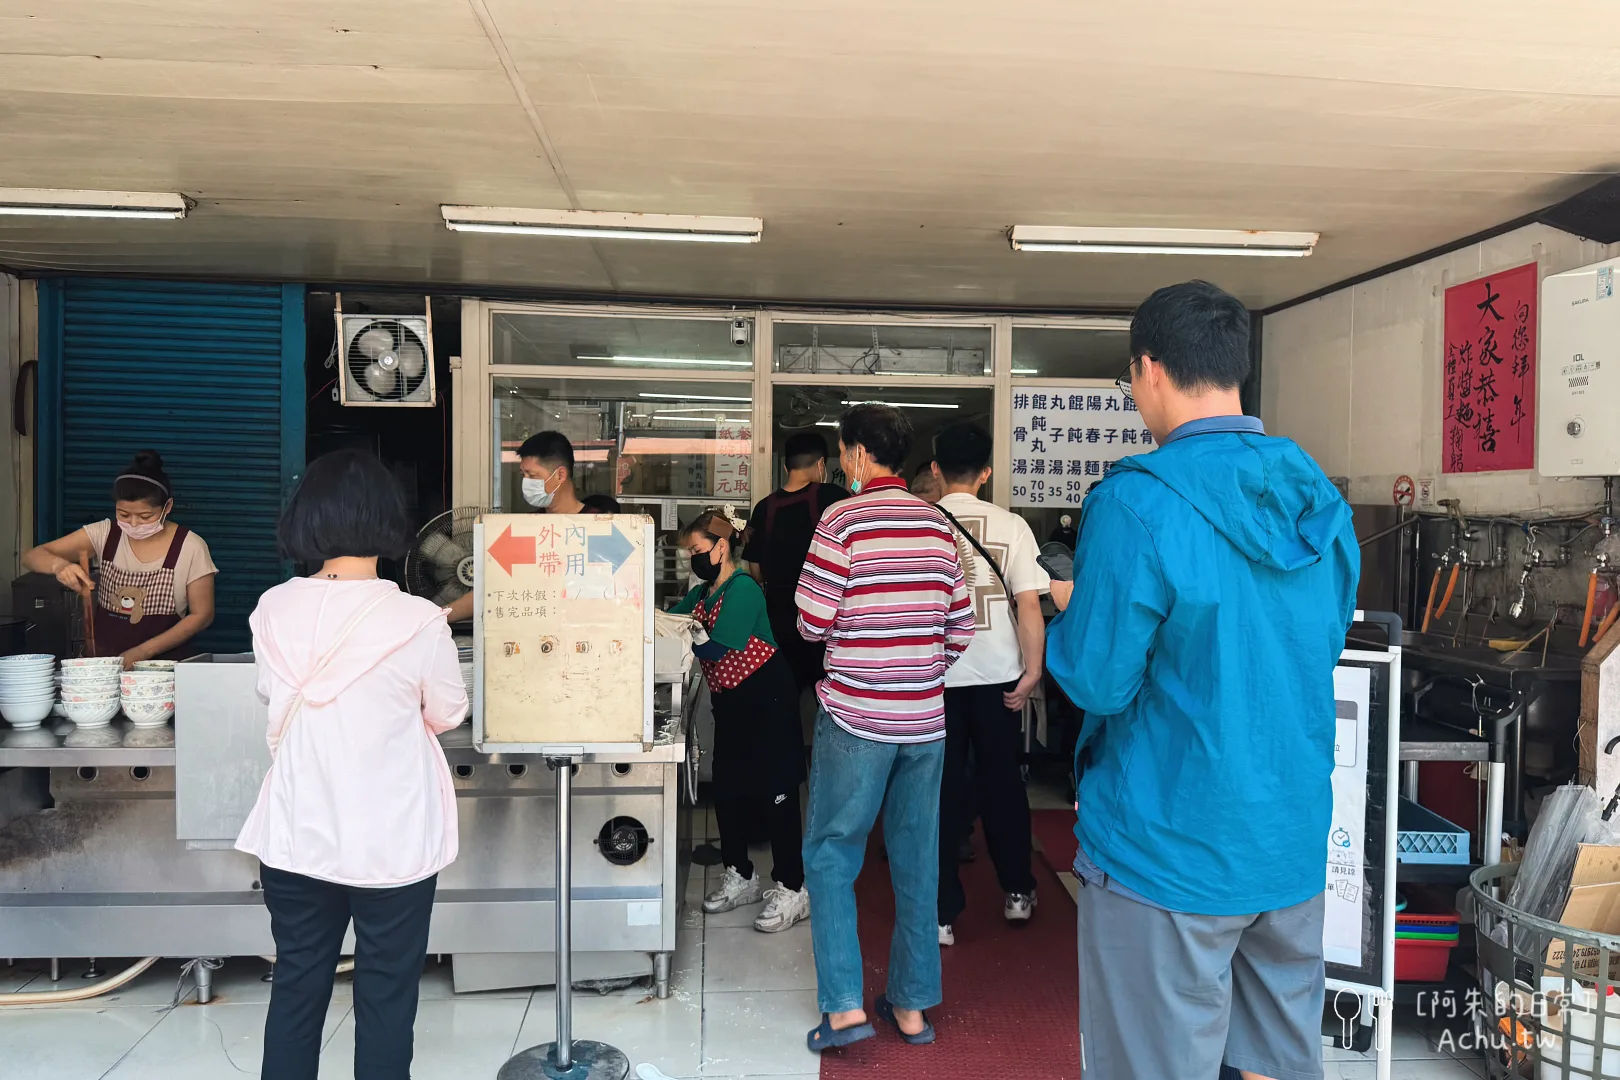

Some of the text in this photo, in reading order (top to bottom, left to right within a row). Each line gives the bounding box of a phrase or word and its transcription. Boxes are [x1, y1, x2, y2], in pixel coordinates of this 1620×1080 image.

[1012, 393, 1029, 496] 排骨湯 50
[1030, 393, 1047, 503] 餛飩丸湯 70 55
[1048, 395, 1066, 497] 丸子湯 35
[1065, 394, 1084, 503] 餛飩湯 50 40
[1084, 395, 1101, 476] 陽春麵
[537, 524, 562, 577] 外帶
[564, 523, 586, 577] 內用
